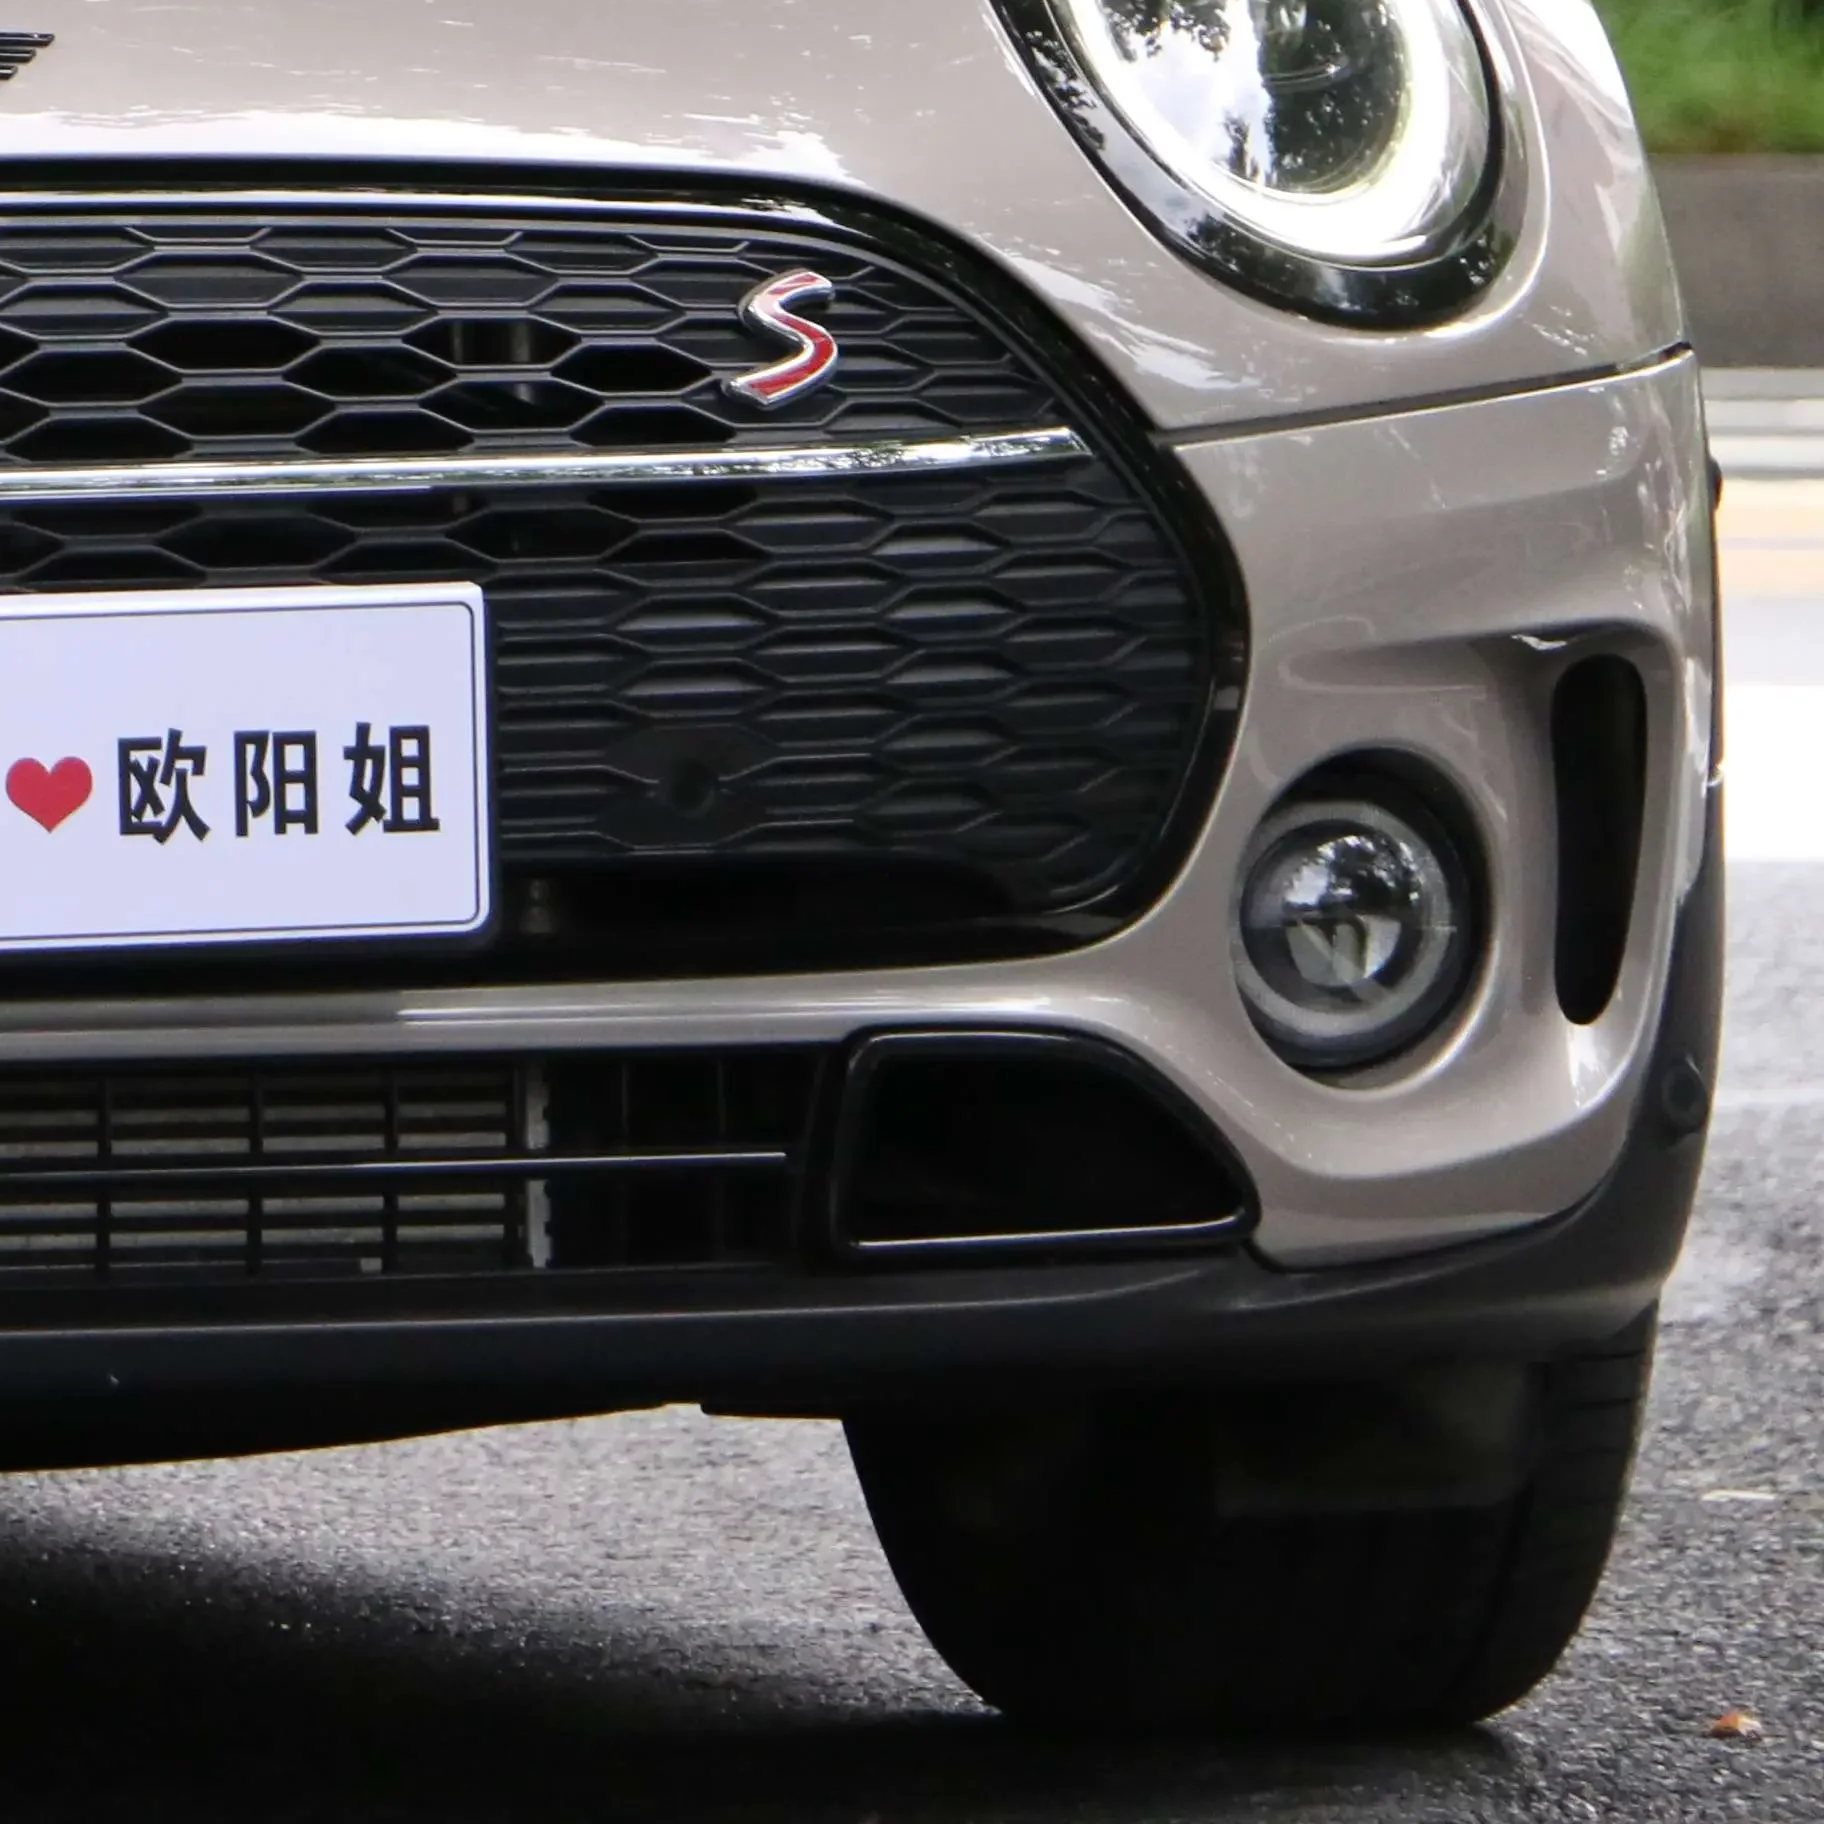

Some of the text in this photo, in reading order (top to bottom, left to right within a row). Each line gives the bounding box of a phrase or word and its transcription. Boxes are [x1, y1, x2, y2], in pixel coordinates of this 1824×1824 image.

[724, 268, 839, 410] S
[117, 721, 441, 845] 欧阳姐
